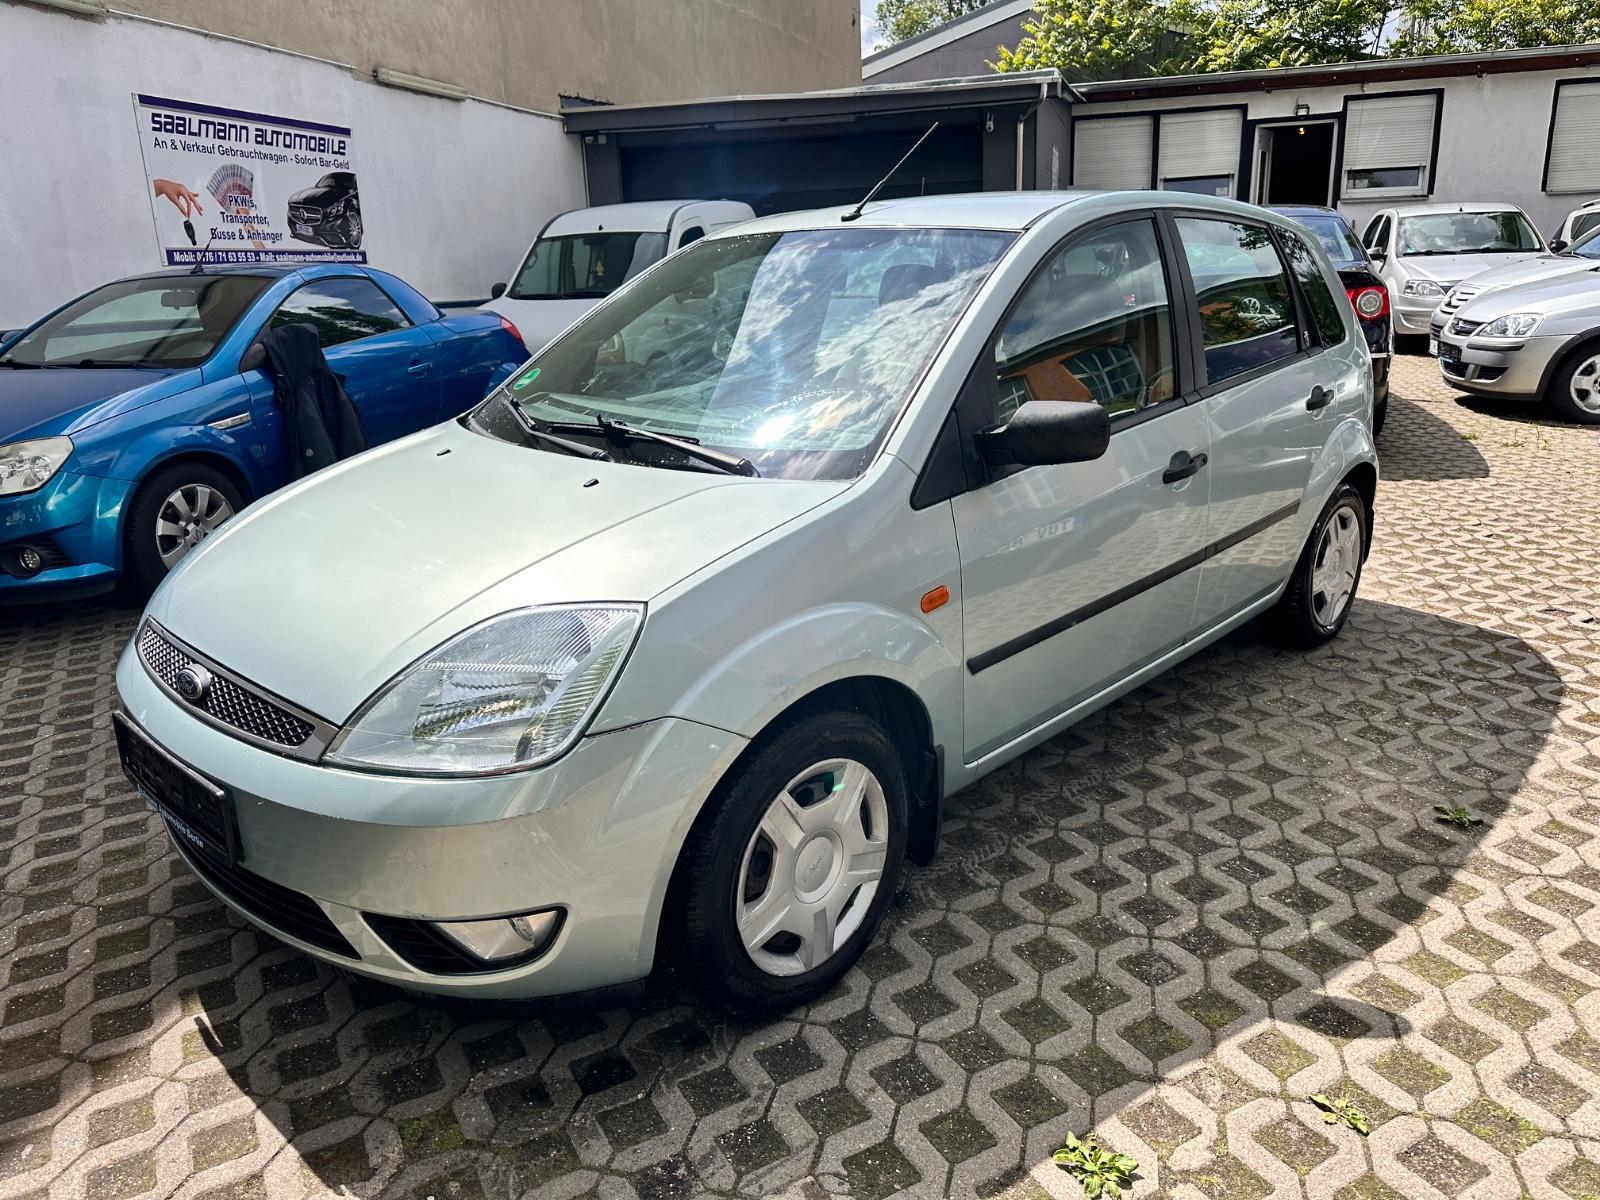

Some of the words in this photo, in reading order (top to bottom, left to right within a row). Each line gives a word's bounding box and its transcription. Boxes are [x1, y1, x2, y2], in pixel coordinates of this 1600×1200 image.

[154, 136, 168, 150] An
[170, 138, 178, 151] &
[179, 139, 216, 155] Verkauf
[217, 144, 288, 165] Gebrauchtwagen
[294, 154, 319, 167] Sofort
[319, 157, 350, 170] Bar-Geld
[220, 211, 270, 227] Transporter,
[210, 227, 236, 240] Busse
[238, 228, 245, 241] &
[247, 229, 283, 244] Anhänger
[173, 251, 195, 262] Mobil:
[218, 251, 226, 262] 71
[228, 251, 237, 262] 63
[237, 251, 246, 262] 55
[246, 251, 255, 262] 53
